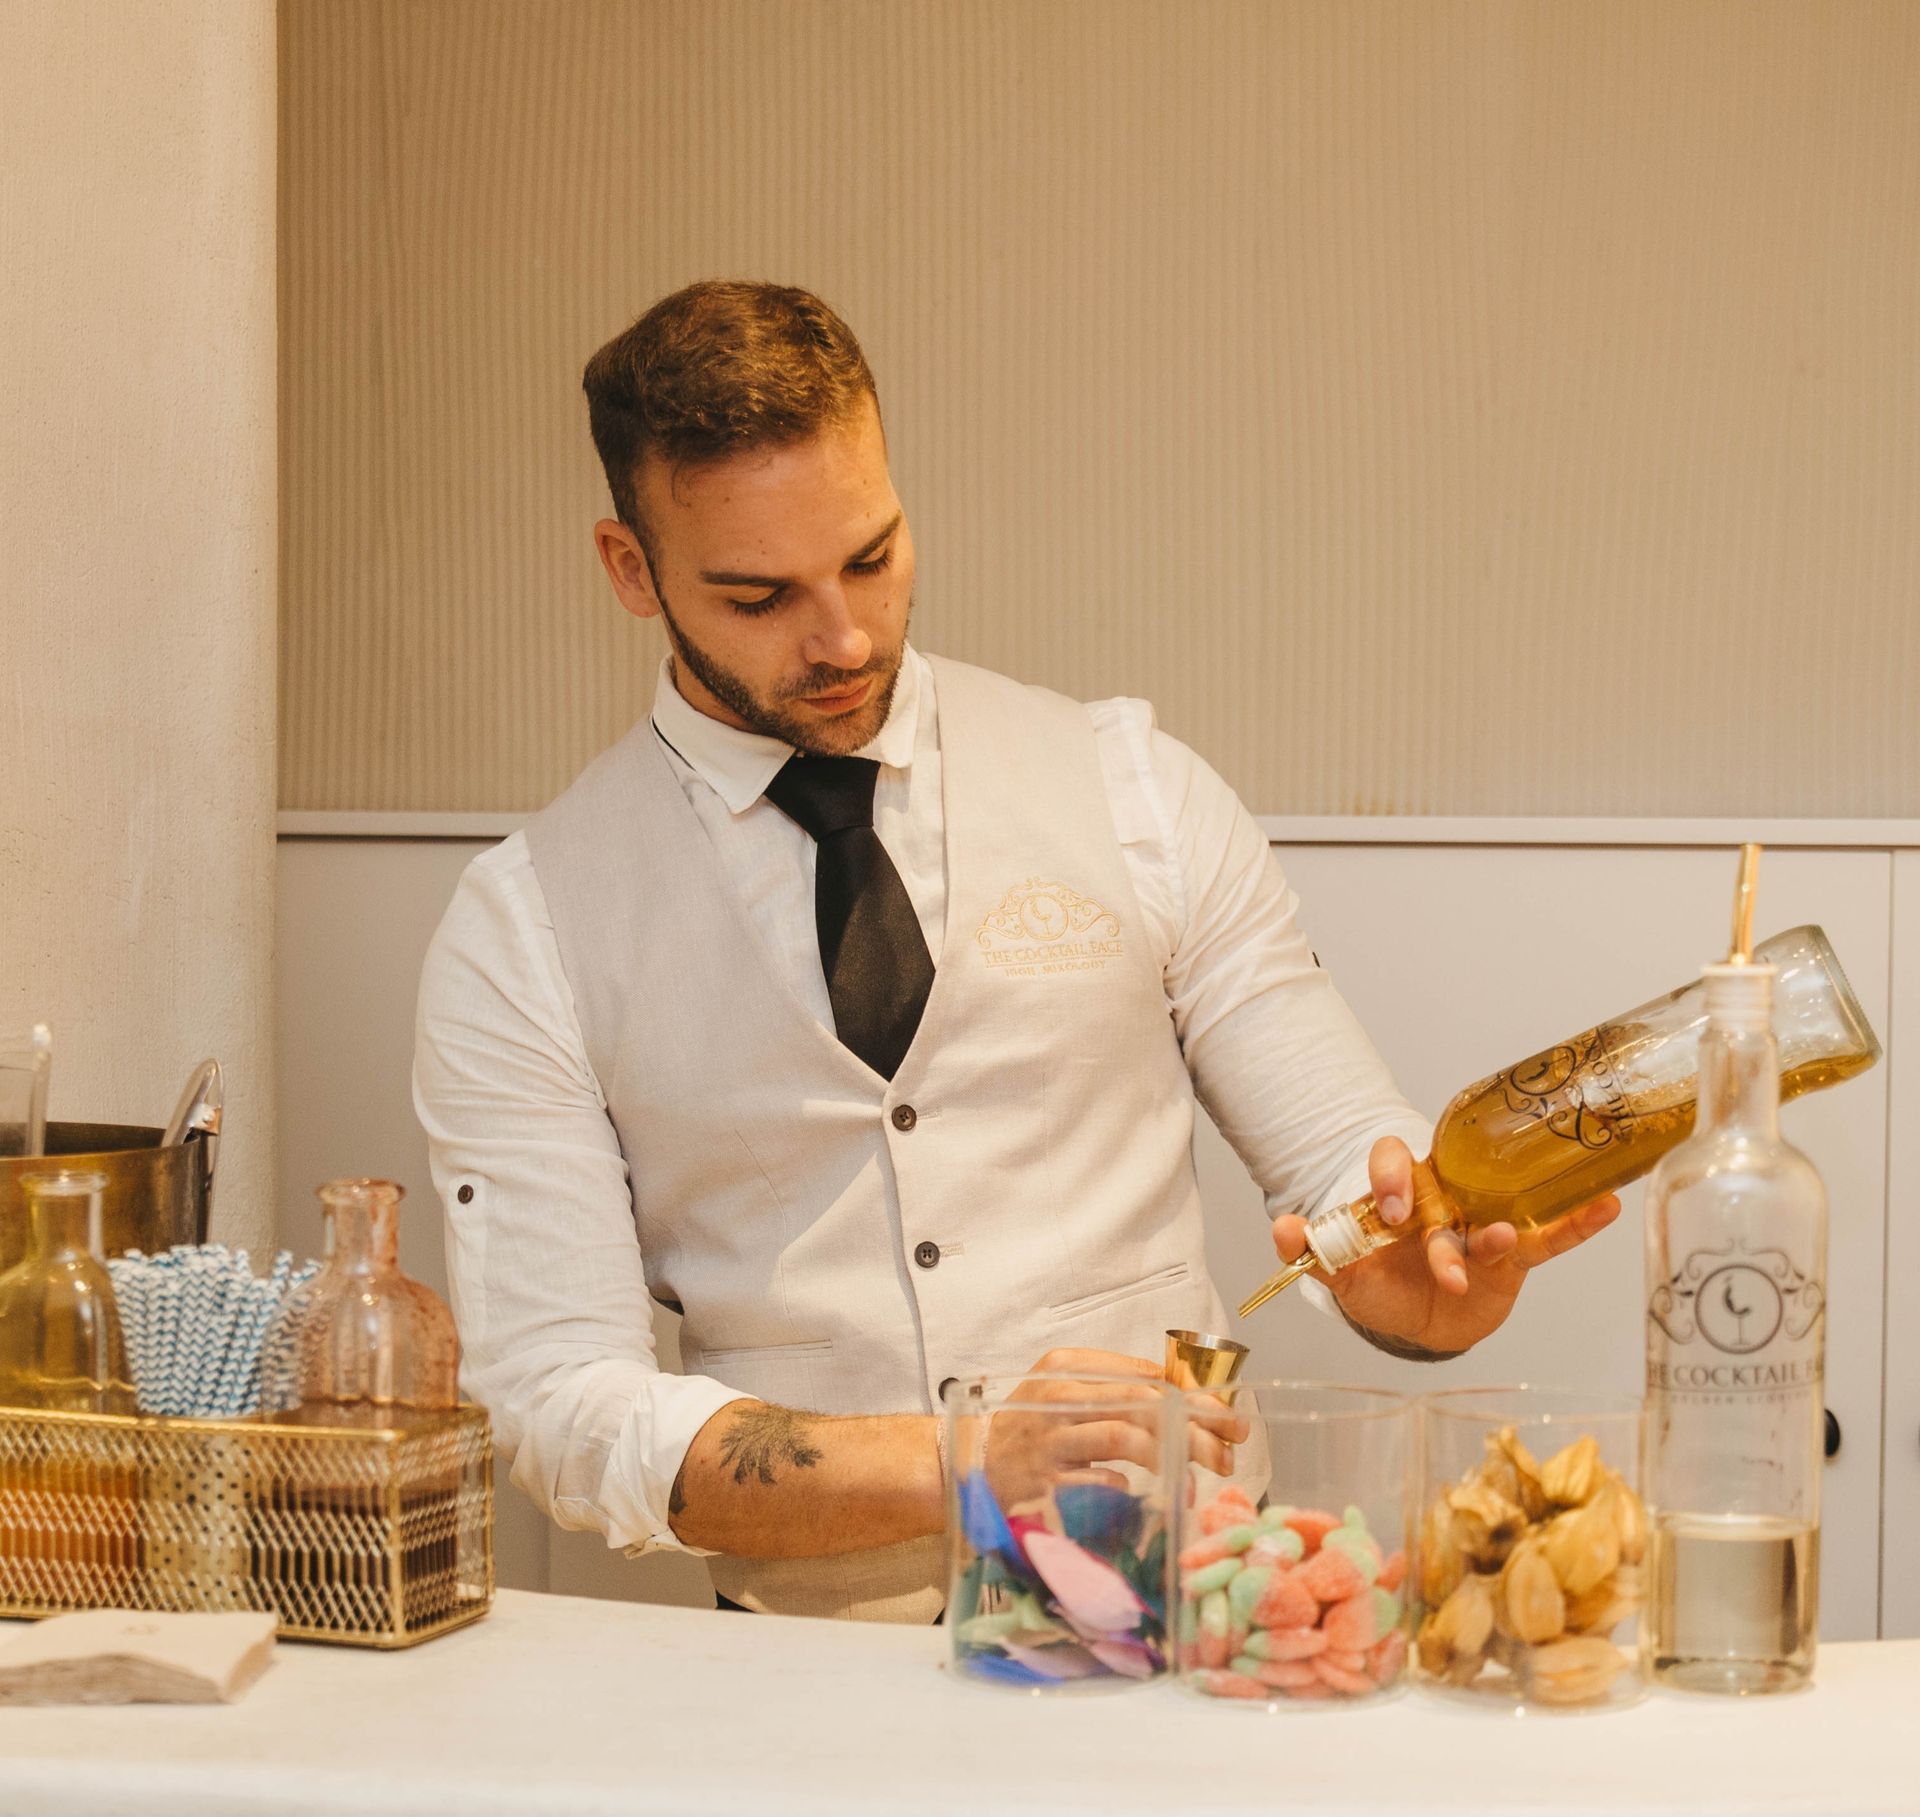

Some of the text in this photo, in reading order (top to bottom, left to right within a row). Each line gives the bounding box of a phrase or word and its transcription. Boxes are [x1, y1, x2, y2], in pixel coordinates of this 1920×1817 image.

[981, 951, 1012, 964] THE
[1015, 943, 1088, 961] COCKTAIL
[1673, 1362, 1797, 1388] COCKTAIL
